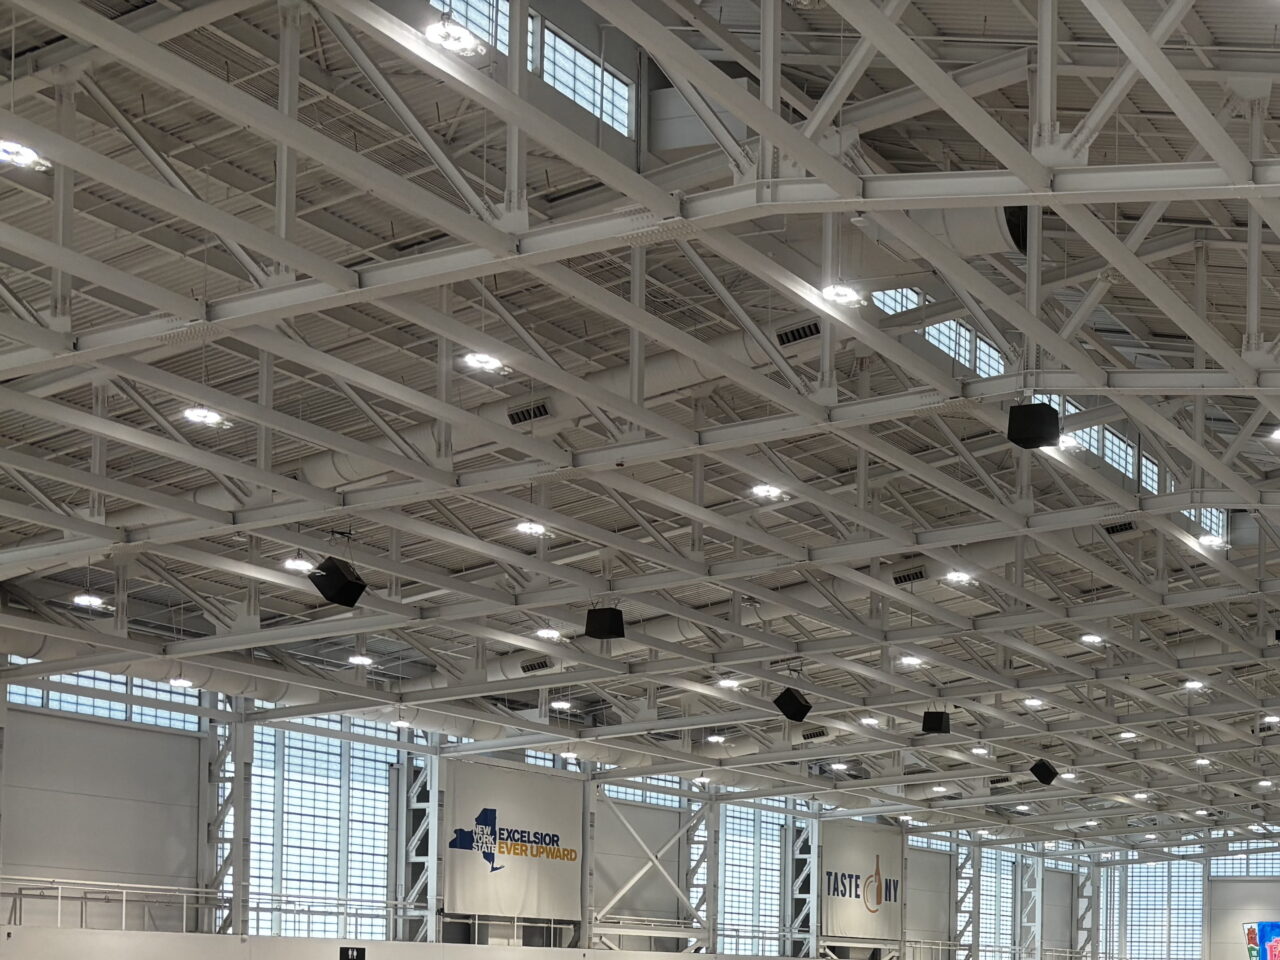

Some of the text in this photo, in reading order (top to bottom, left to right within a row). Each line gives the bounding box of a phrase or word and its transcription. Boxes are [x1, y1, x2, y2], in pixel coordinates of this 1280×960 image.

[473, 825, 492, 834] NEW
[498, 827, 560, 847] EXCELSIOR
[473, 834, 495, 844] YORK
[472, 843, 497, 853] STATE
[498, 841, 577, 862] EVER UPWARD
[826, 871, 899, 902] TASTE NY
